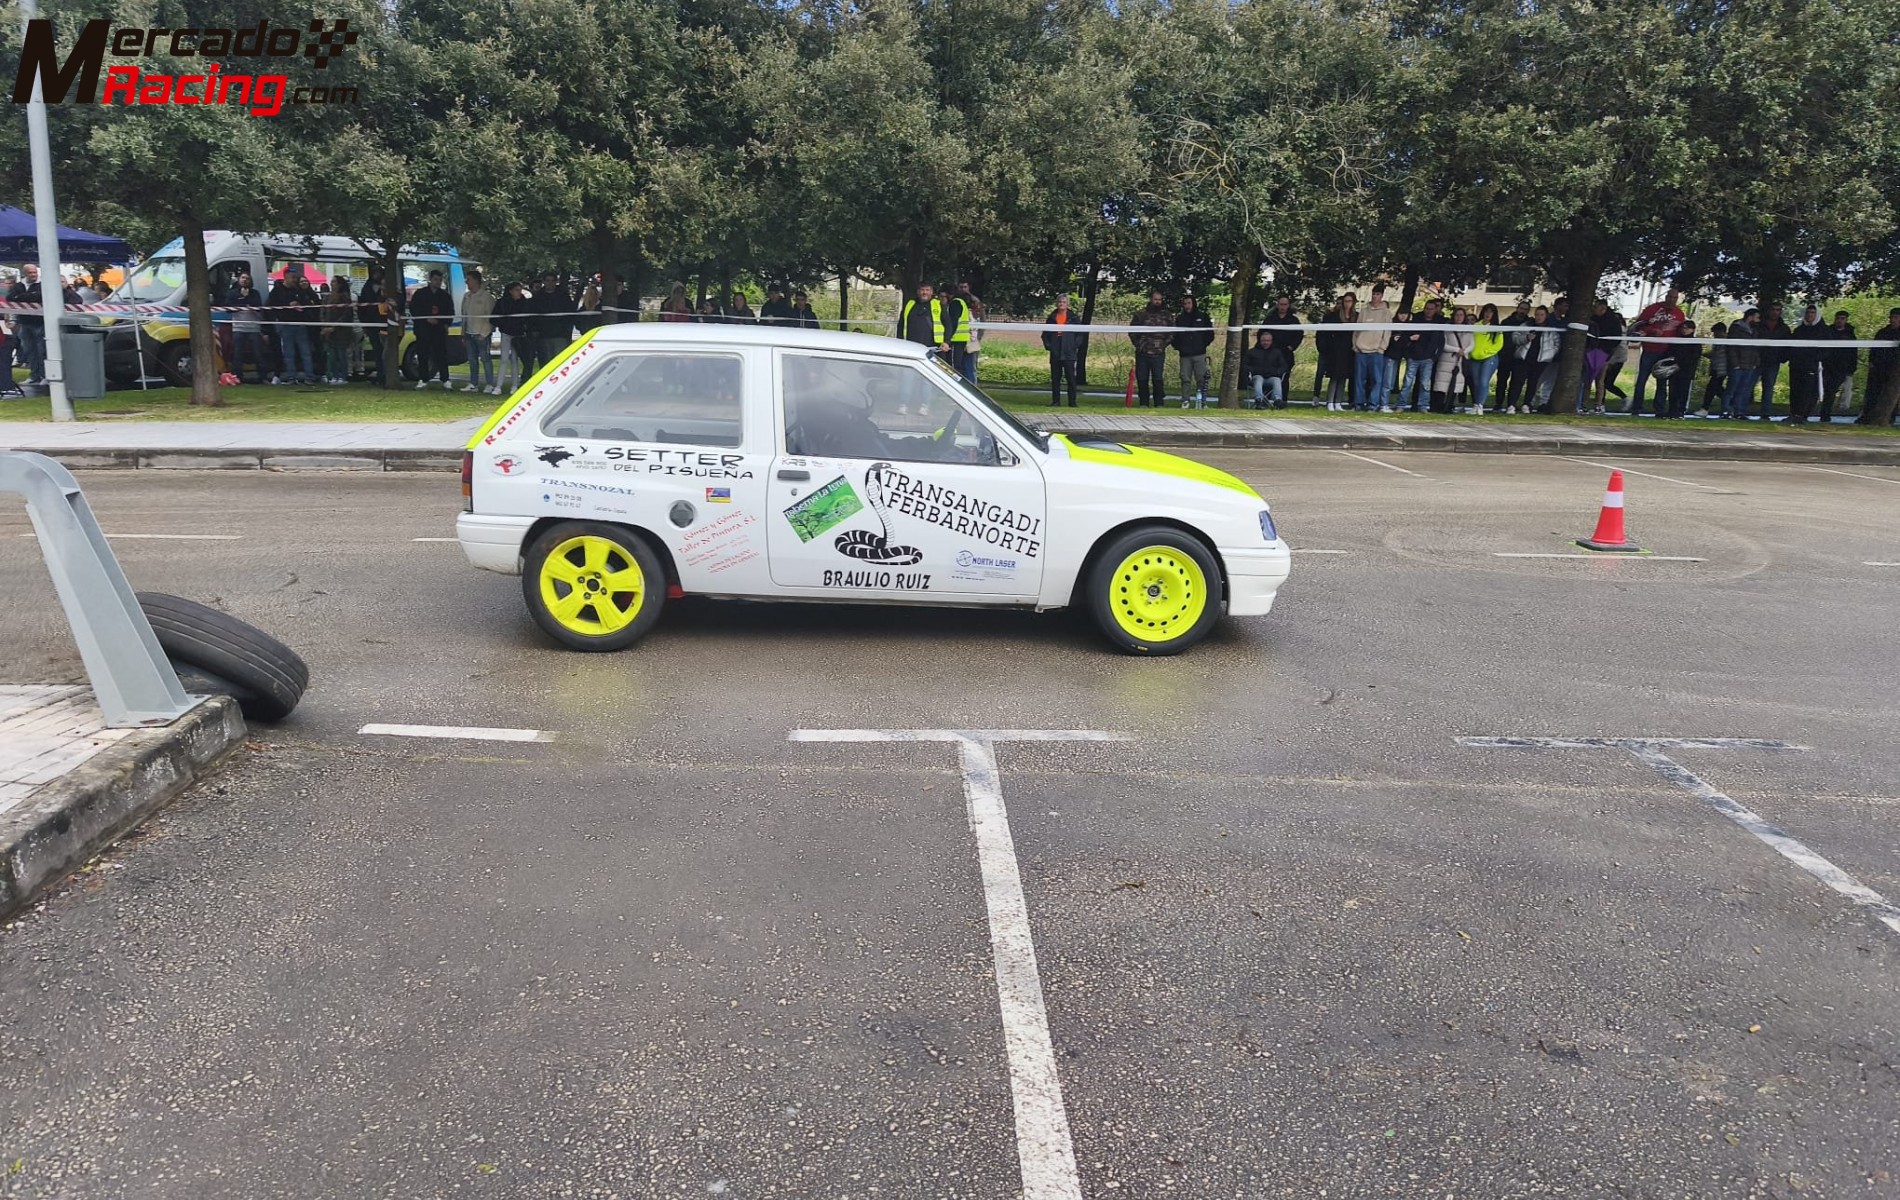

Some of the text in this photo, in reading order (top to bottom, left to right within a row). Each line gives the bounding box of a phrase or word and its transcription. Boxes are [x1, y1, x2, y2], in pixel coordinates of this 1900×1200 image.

[484, 342, 595, 445] Ramiro Sport
[604, 447, 745, 467] SETTER
[613, 464, 754, 480] DEL PISUEÑA
[540, 478, 636, 496] TRANSNOZAL
[884, 470, 1040, 536] TRANSANGADI
[886, 492, 1040, 558] FERBARNORTE
[823, 569, 891, 588] BRAULIO
[895, 572, 932, 590] RUIZ
